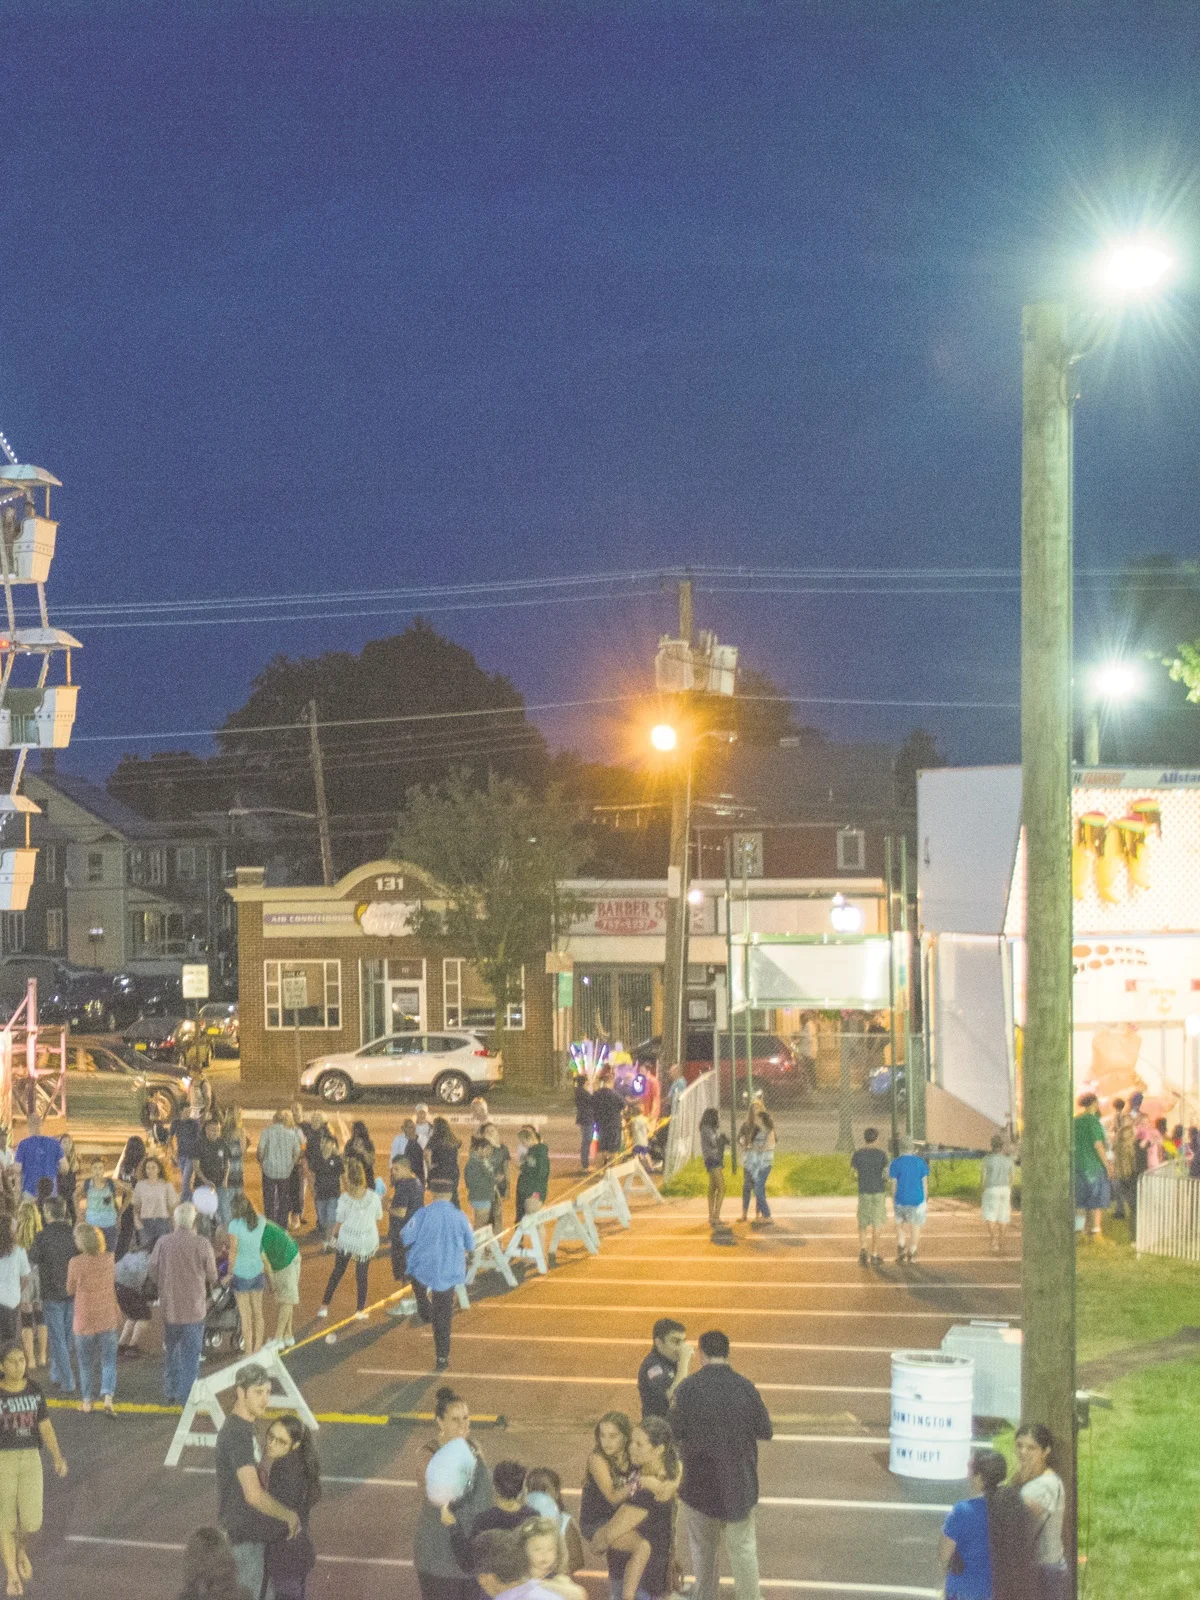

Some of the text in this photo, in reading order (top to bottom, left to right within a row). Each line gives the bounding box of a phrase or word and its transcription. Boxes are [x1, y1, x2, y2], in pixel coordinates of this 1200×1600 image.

[375, 876, 404, 891] 131
[597, 901, 650, 917] BARBER
[270, 915, 287, 923] AIR
